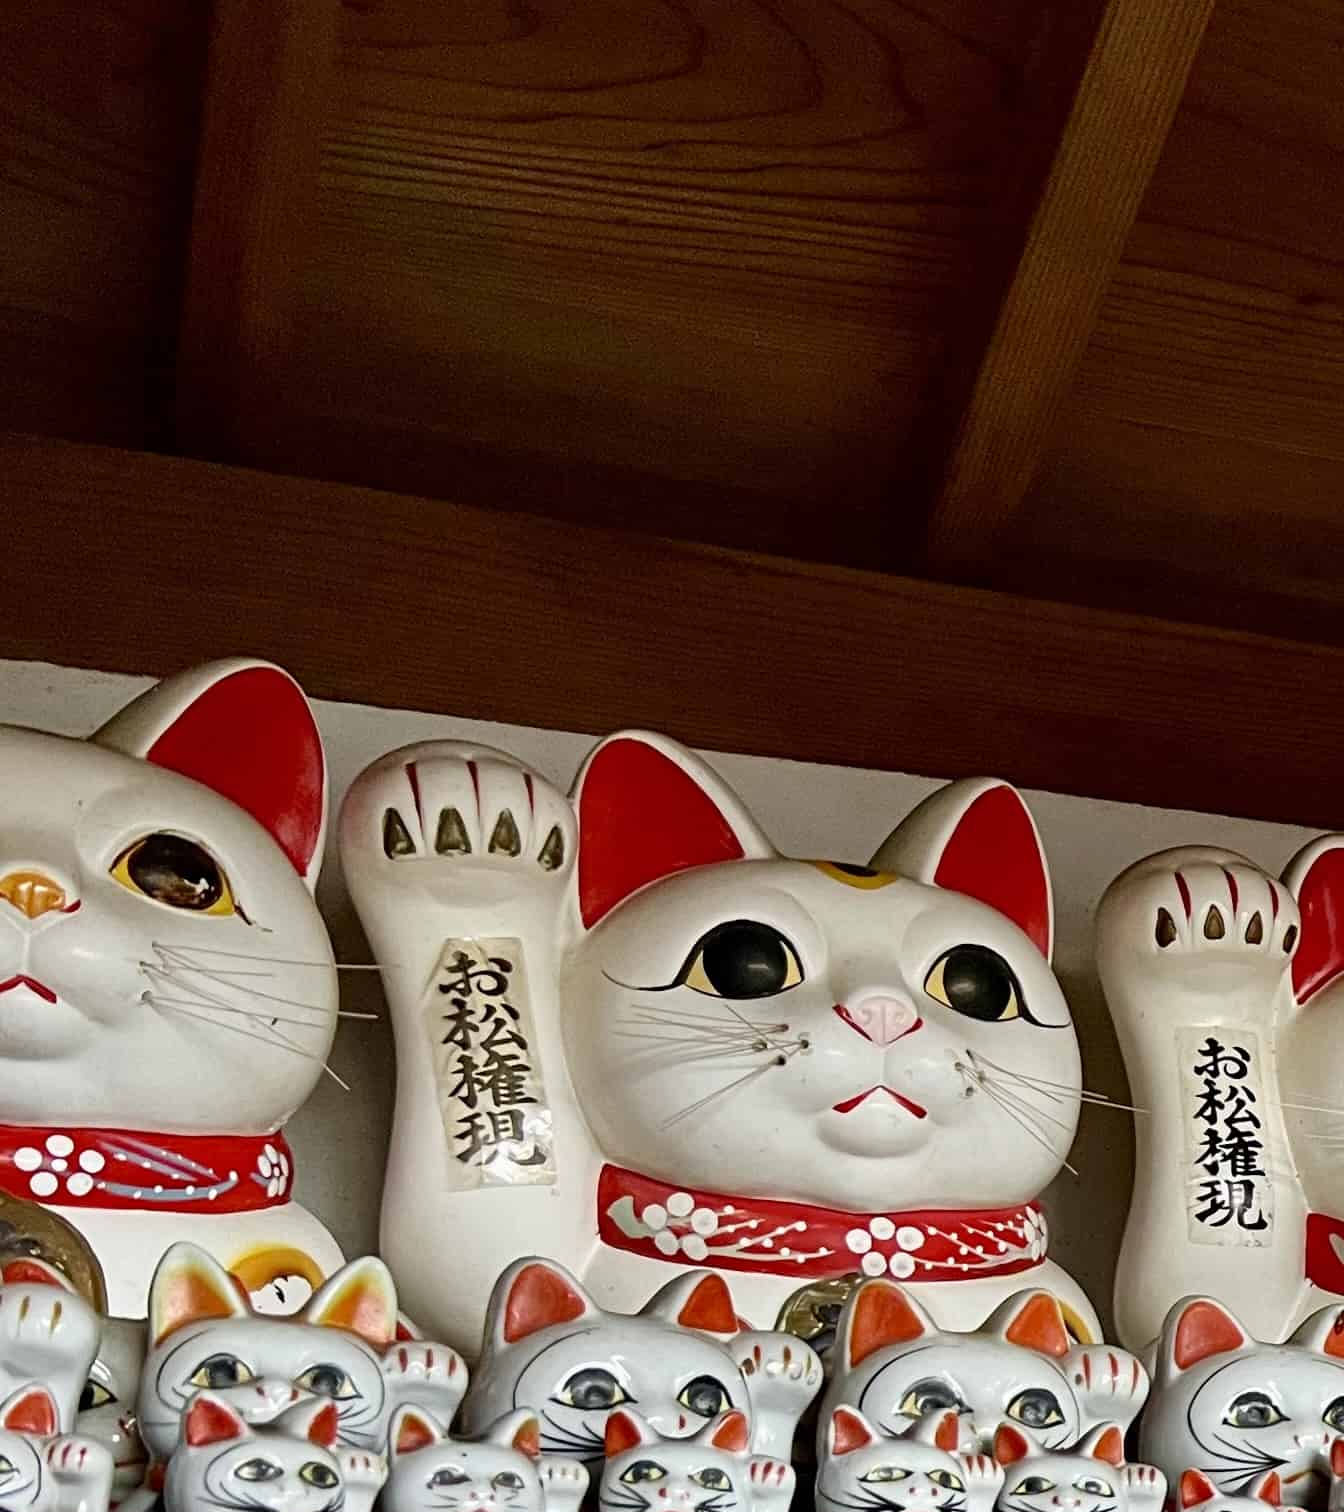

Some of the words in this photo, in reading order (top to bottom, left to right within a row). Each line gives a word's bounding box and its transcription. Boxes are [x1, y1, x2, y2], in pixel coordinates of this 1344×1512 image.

[439, 951, 546, 1166] お松権現
[1194, 1038, 1267, 1231] お松権現
